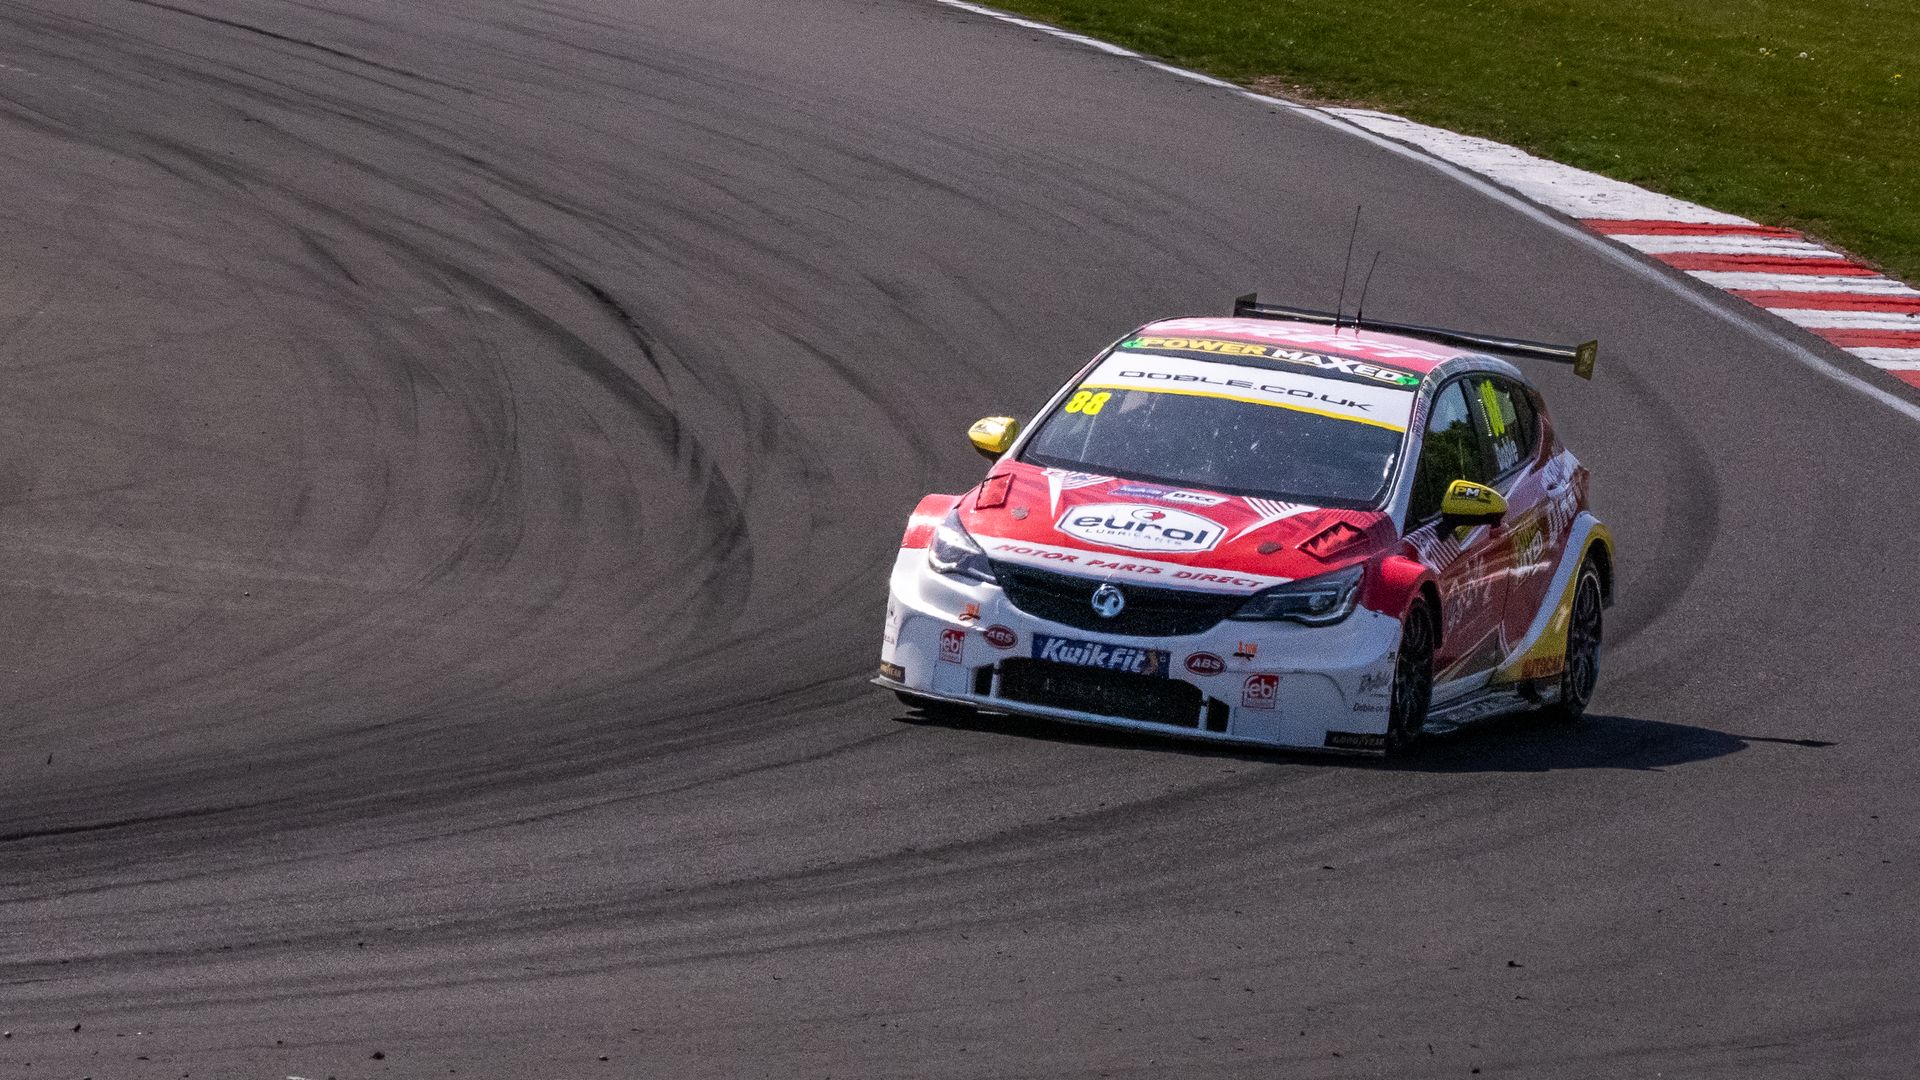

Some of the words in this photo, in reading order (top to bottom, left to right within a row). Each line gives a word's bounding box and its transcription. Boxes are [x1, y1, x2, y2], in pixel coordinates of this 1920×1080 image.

[1143, 338, 1267, 356] POWER
[1272, 350, 1400, 381] MAXED
[1065, 390, 1112, 415] 88
[1119, 370, 1374, 412] DOBLE.CO.UK
[1073, 514, 1209, 544] eurol
[994, 544, 1079, 563] MOTOR
[1086, 558, 1162, 575] PARTS
[1172, 570, 1265, 588] DIRECT
[987, 630, 1014, 643] ABS
[1191, 658, 1221, 669] ABS
